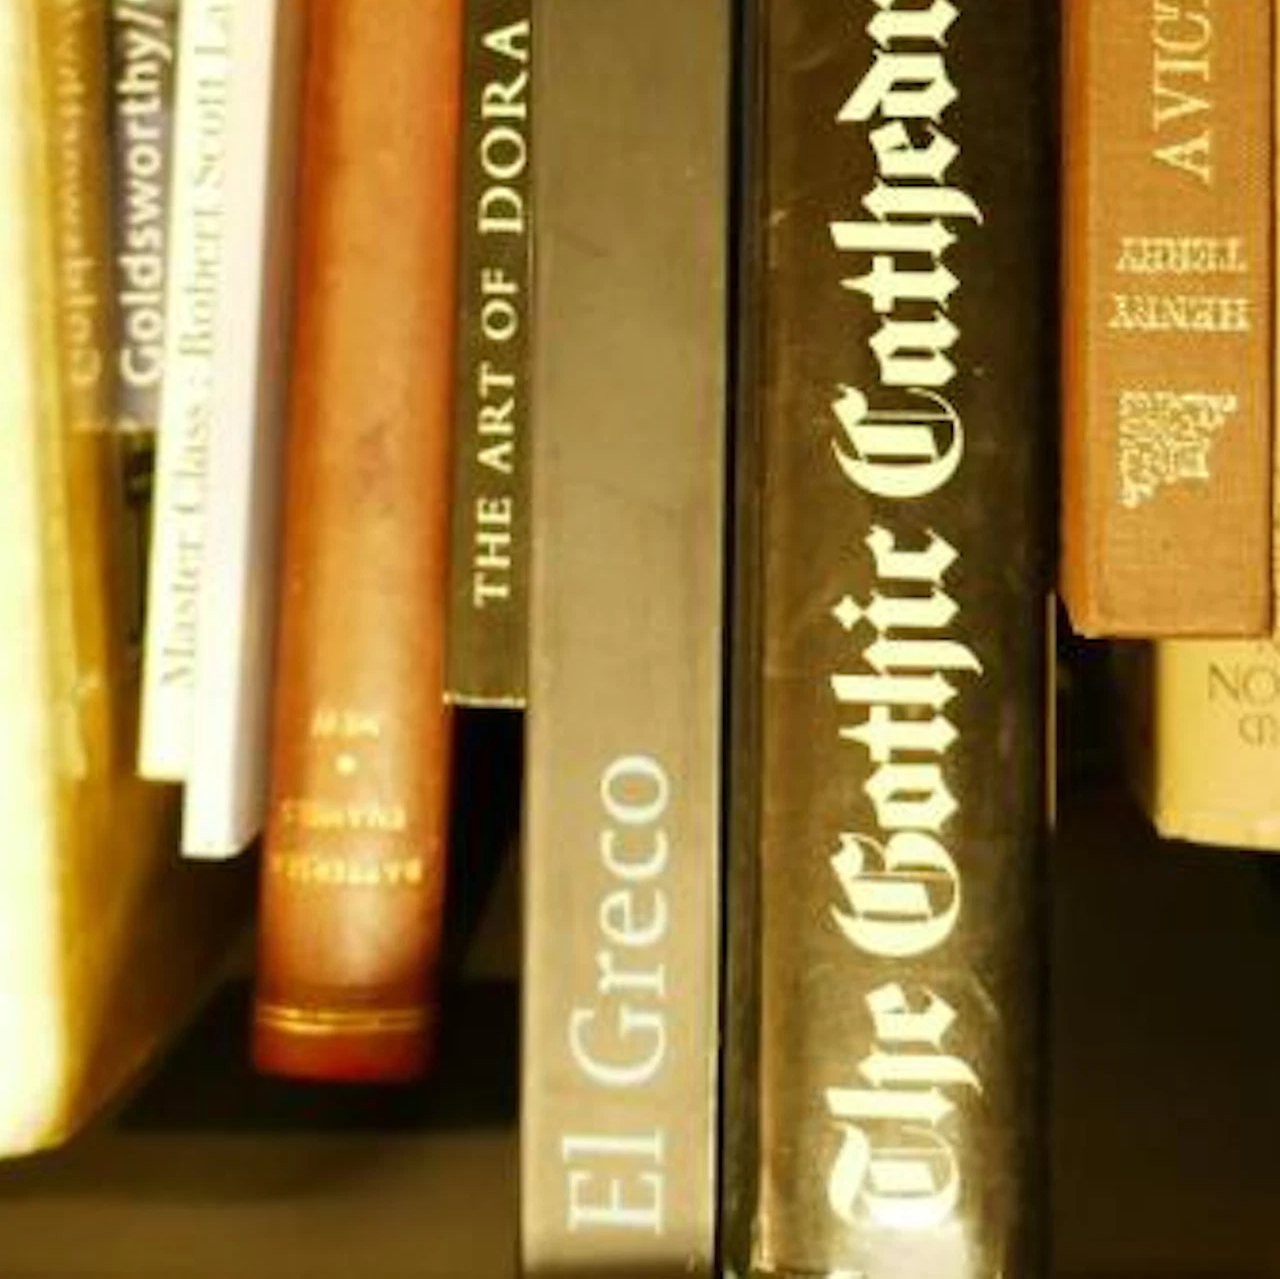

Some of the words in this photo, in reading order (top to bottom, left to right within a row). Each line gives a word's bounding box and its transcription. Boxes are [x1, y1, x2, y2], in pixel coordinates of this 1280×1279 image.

[477, 20, 531, 236] DORA
[1150, 129, 1214, 186] A
[481, 265, 519, 343] OF
[1116, 236, 1248, 275] TERRY
[1107, 294, 1251, 333] HENRY
[475, 360, 516, 475] ART
[473, 497, 513, 610] THE
[827, 522, 985, 959] Gothic
[567, 752, 670, 1089] Greco
[824, 981, 984, 1228] The
[559, 1129, 669, 1240] El
